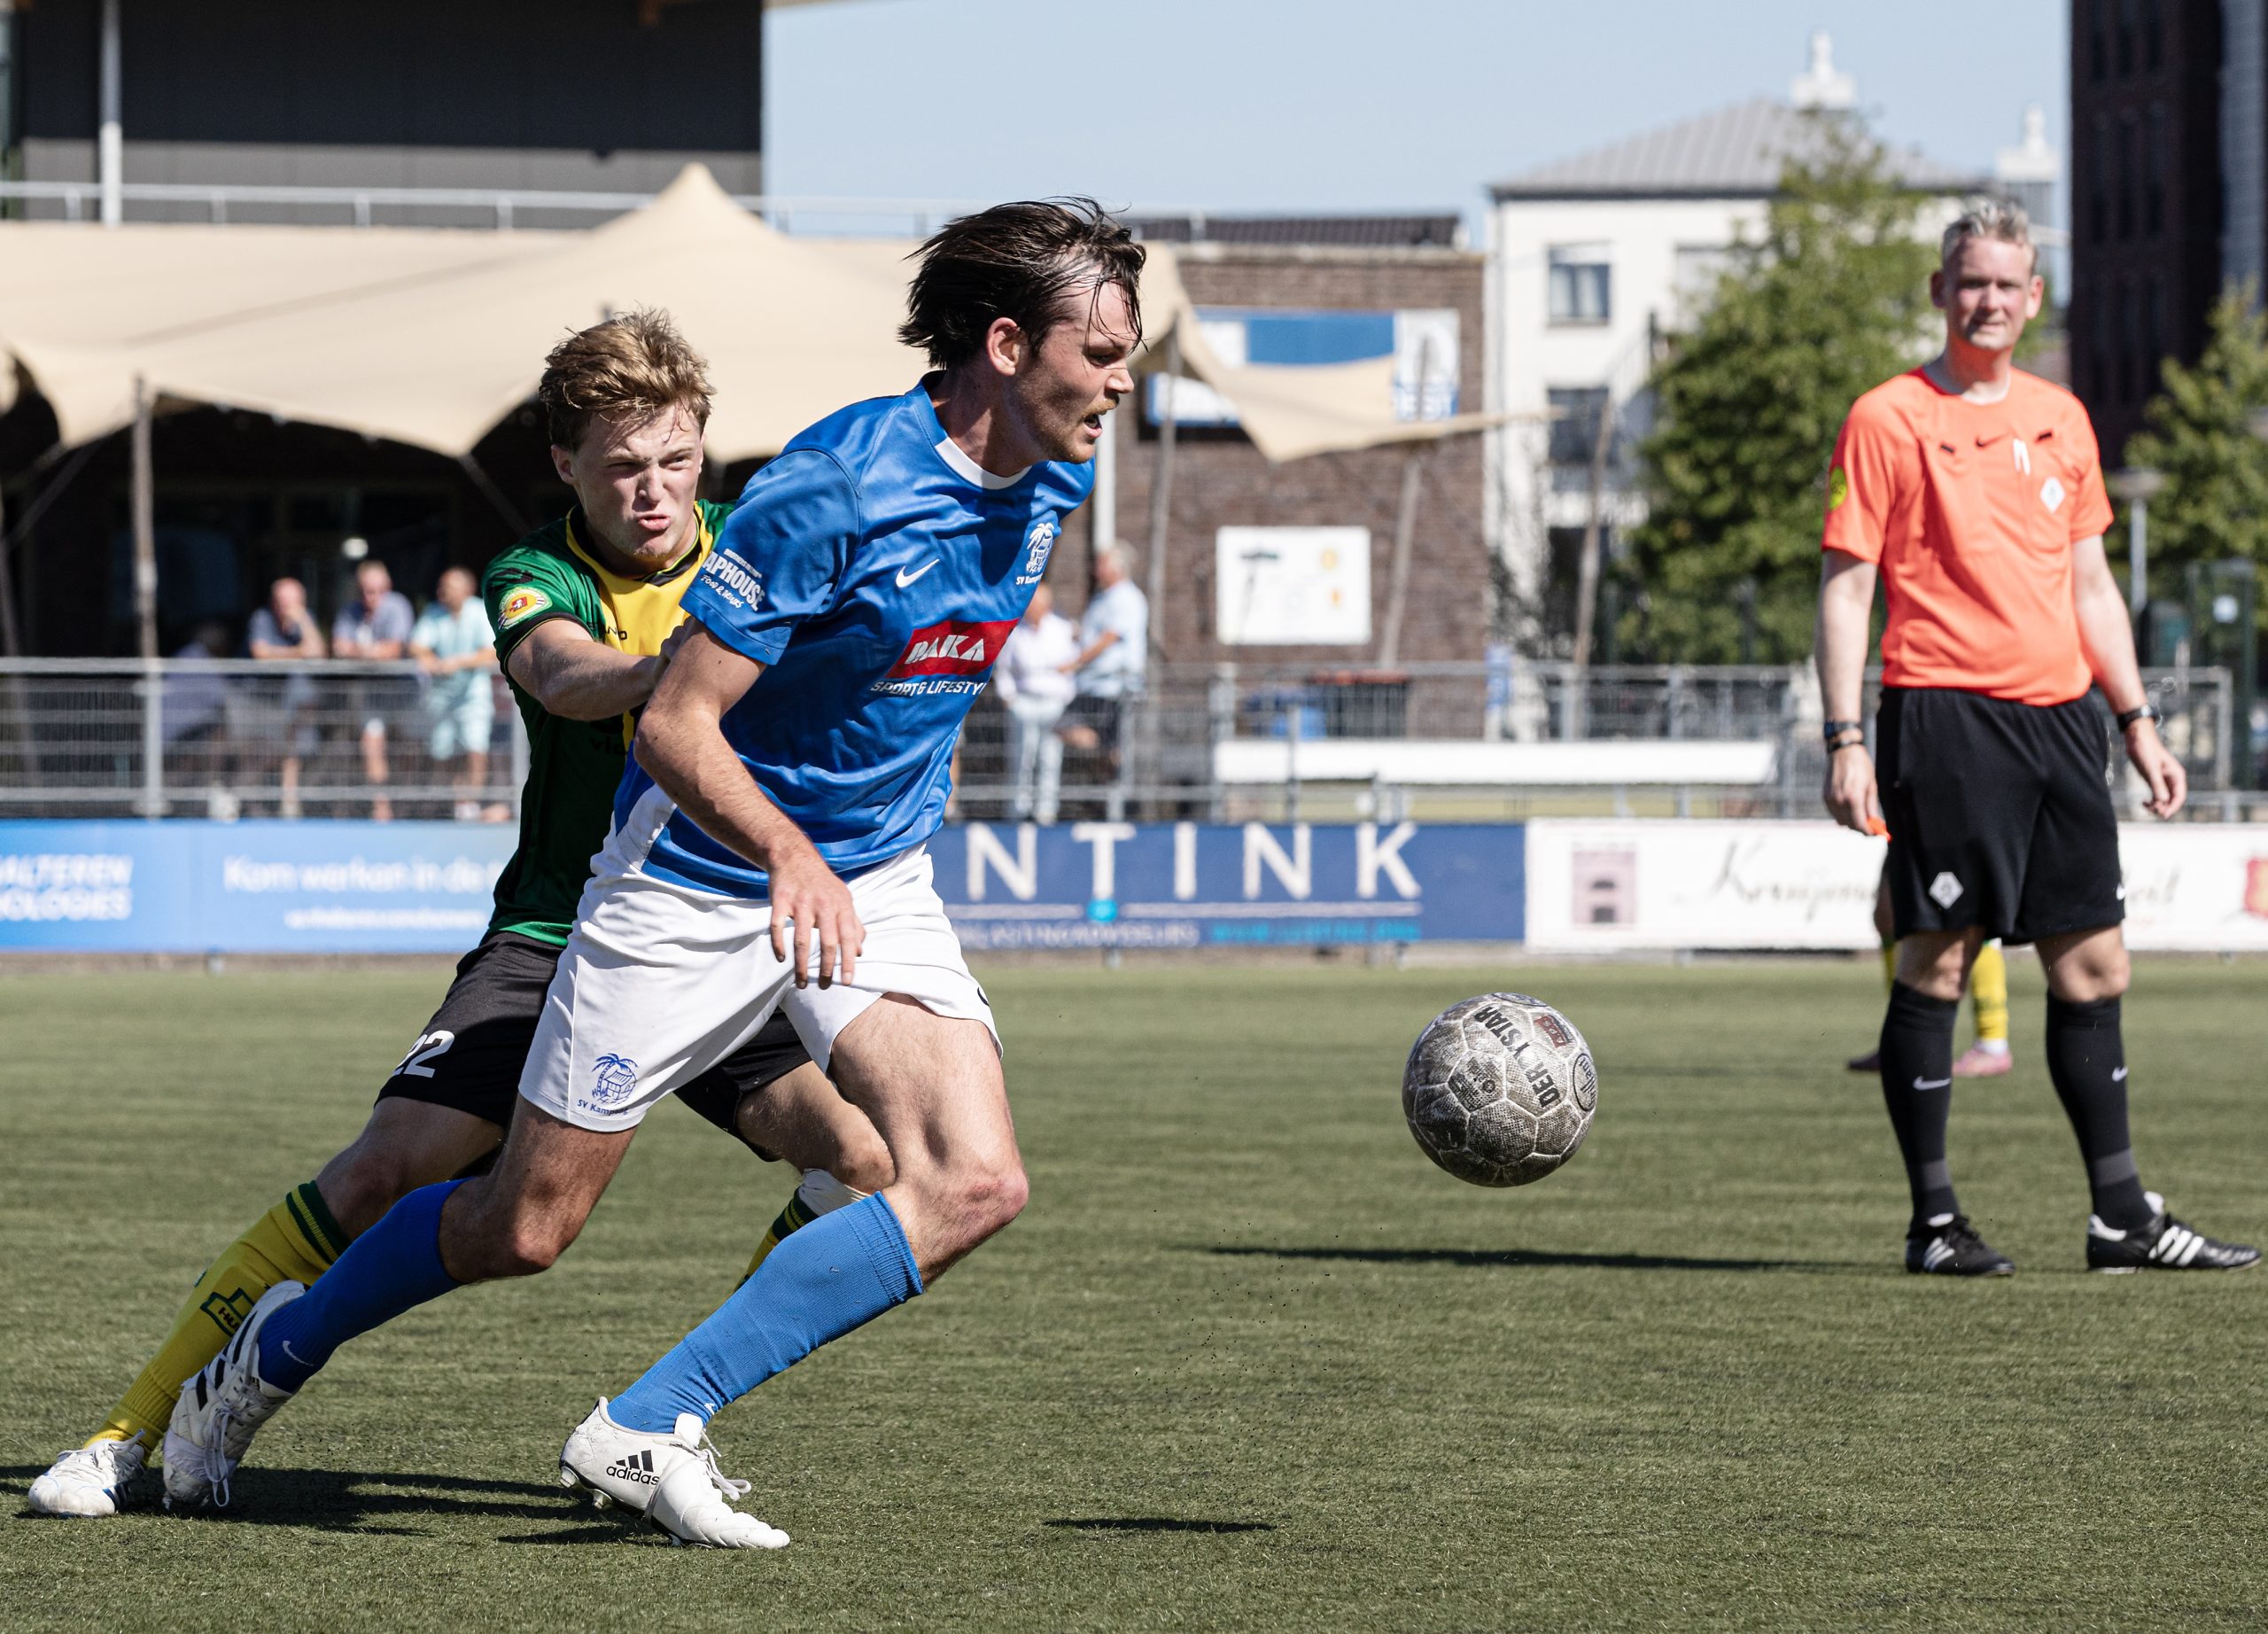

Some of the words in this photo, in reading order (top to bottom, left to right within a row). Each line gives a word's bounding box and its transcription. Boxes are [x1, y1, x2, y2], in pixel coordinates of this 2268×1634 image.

[702, 550, 765, 611] APHOUSE
[905, 634, 985, 665] DAKA
[871, 681, 917, 696] SPORT
[966, 822, 1422, 901] NTINK
[1473, 1006, 1560, 1108] DERYSTAR
[577, 1099, 588, 1108] SV
[606, 1464, 660, 1486] adidas
